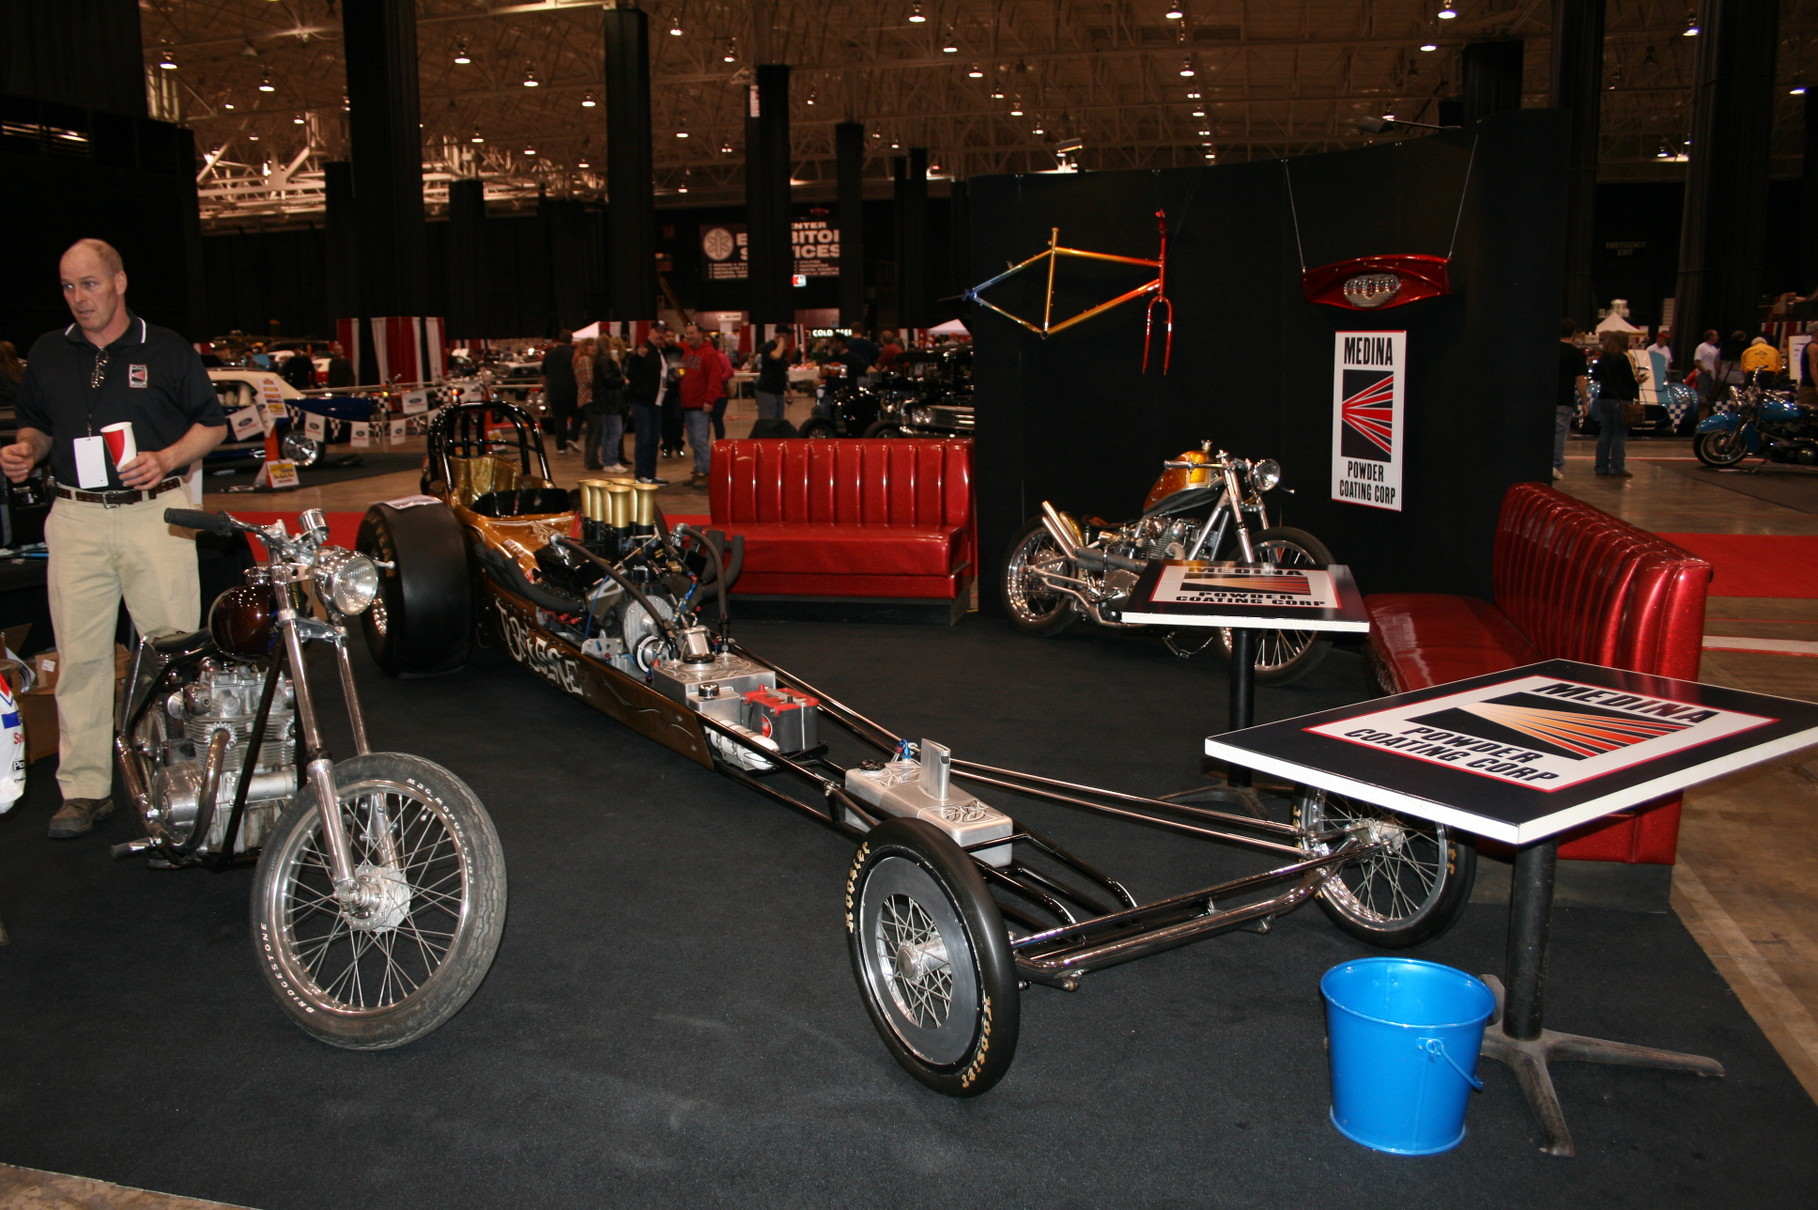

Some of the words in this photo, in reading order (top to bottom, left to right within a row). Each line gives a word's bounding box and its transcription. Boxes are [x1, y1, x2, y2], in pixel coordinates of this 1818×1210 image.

[791, 221, 827, 230] NTER
[812, 328, 834, 338] COLD
[1343, 336, 1394, 367] MEDINA
[1347, 460, 1384, 482] POWDER
[1339, 479, 1372, 501] COATING
[1374, 484, 1396, 505] CORP
[1187, 567, 1304, 576] MEDINA
[1175, 596, 1263, 604] COATING
[1198, 592, 1294, 600] POWDER
[1531, 682, 1720, 724] MEDINA
[1344, 728, 1471, 761] COATING
[1465, 757, 1560, 782] CORP
[1400, 727, 1544, 763] POWDER
[260, 922, 315, 1014] BRIDGESTONE
